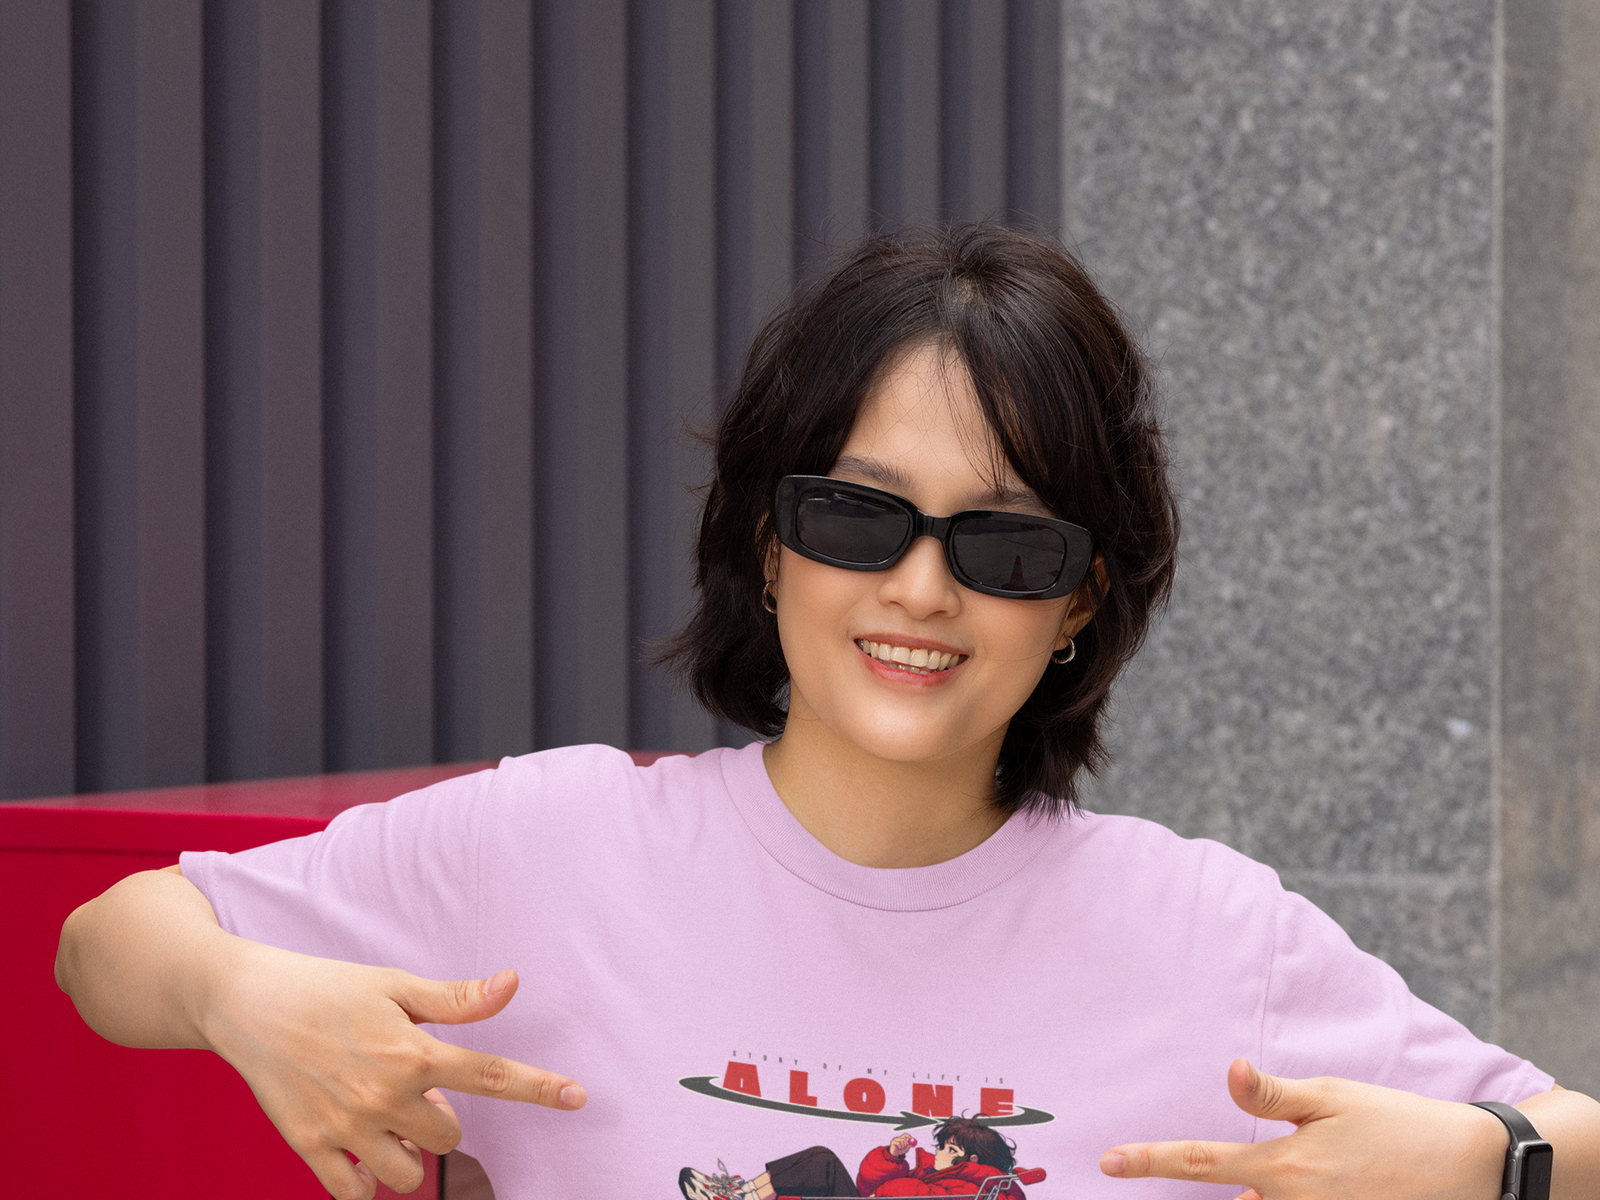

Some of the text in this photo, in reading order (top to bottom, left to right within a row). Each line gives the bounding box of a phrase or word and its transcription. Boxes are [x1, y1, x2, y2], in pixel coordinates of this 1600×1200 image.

[732, 1050, 798, 1066] STORY
[823, 1063, 842, 1071] OF
[867, 1068, 888, 1076] MY
[912, 1072, 960, 1082] LIFE
[723, 1060, 1014, 1117] ALONE
